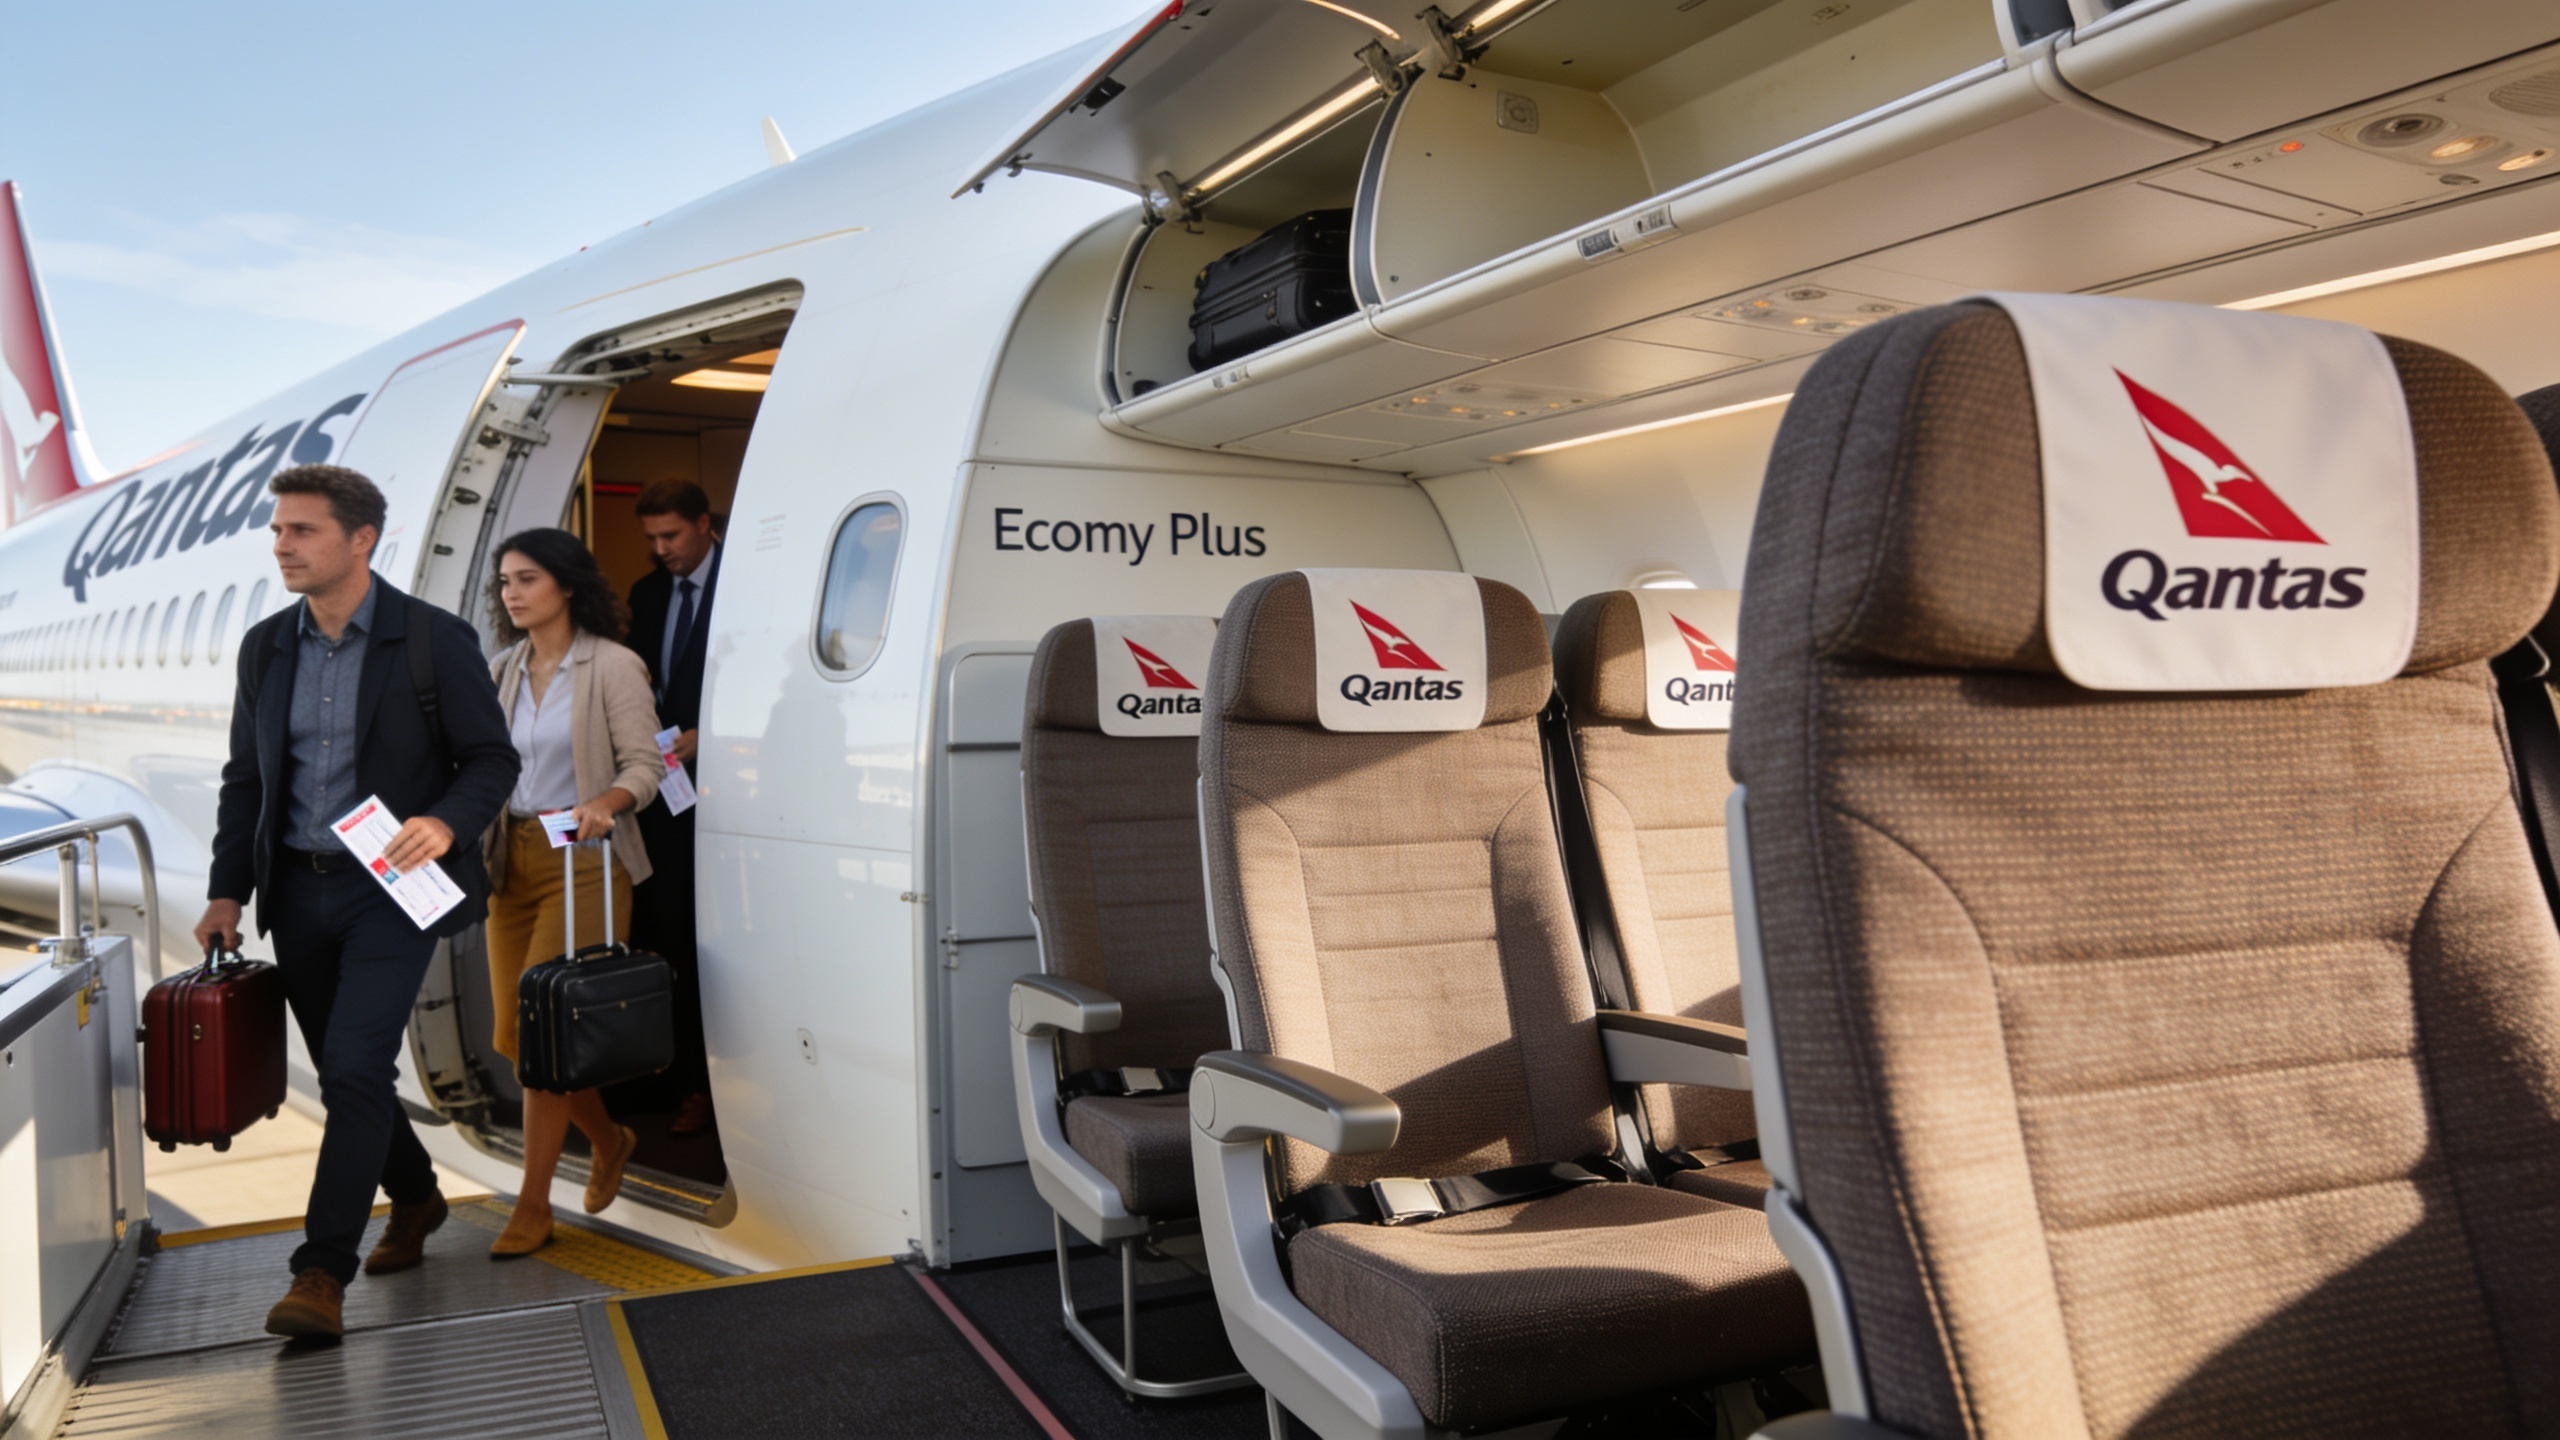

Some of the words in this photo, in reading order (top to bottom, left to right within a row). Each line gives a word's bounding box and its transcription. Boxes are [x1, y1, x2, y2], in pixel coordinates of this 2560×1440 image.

[63, 392, 369, 603] Qantas
[994, 507, 1155, 566] Ecomy
[1170, 512, 1267, 557] Plus
[2101, 549, 2368, 621] Qantas
[1116, 693, 1203, 719] Qanta
[1340, 674, 1464, 706] Qantas
[1665, 677, 1736, 706] Qant
